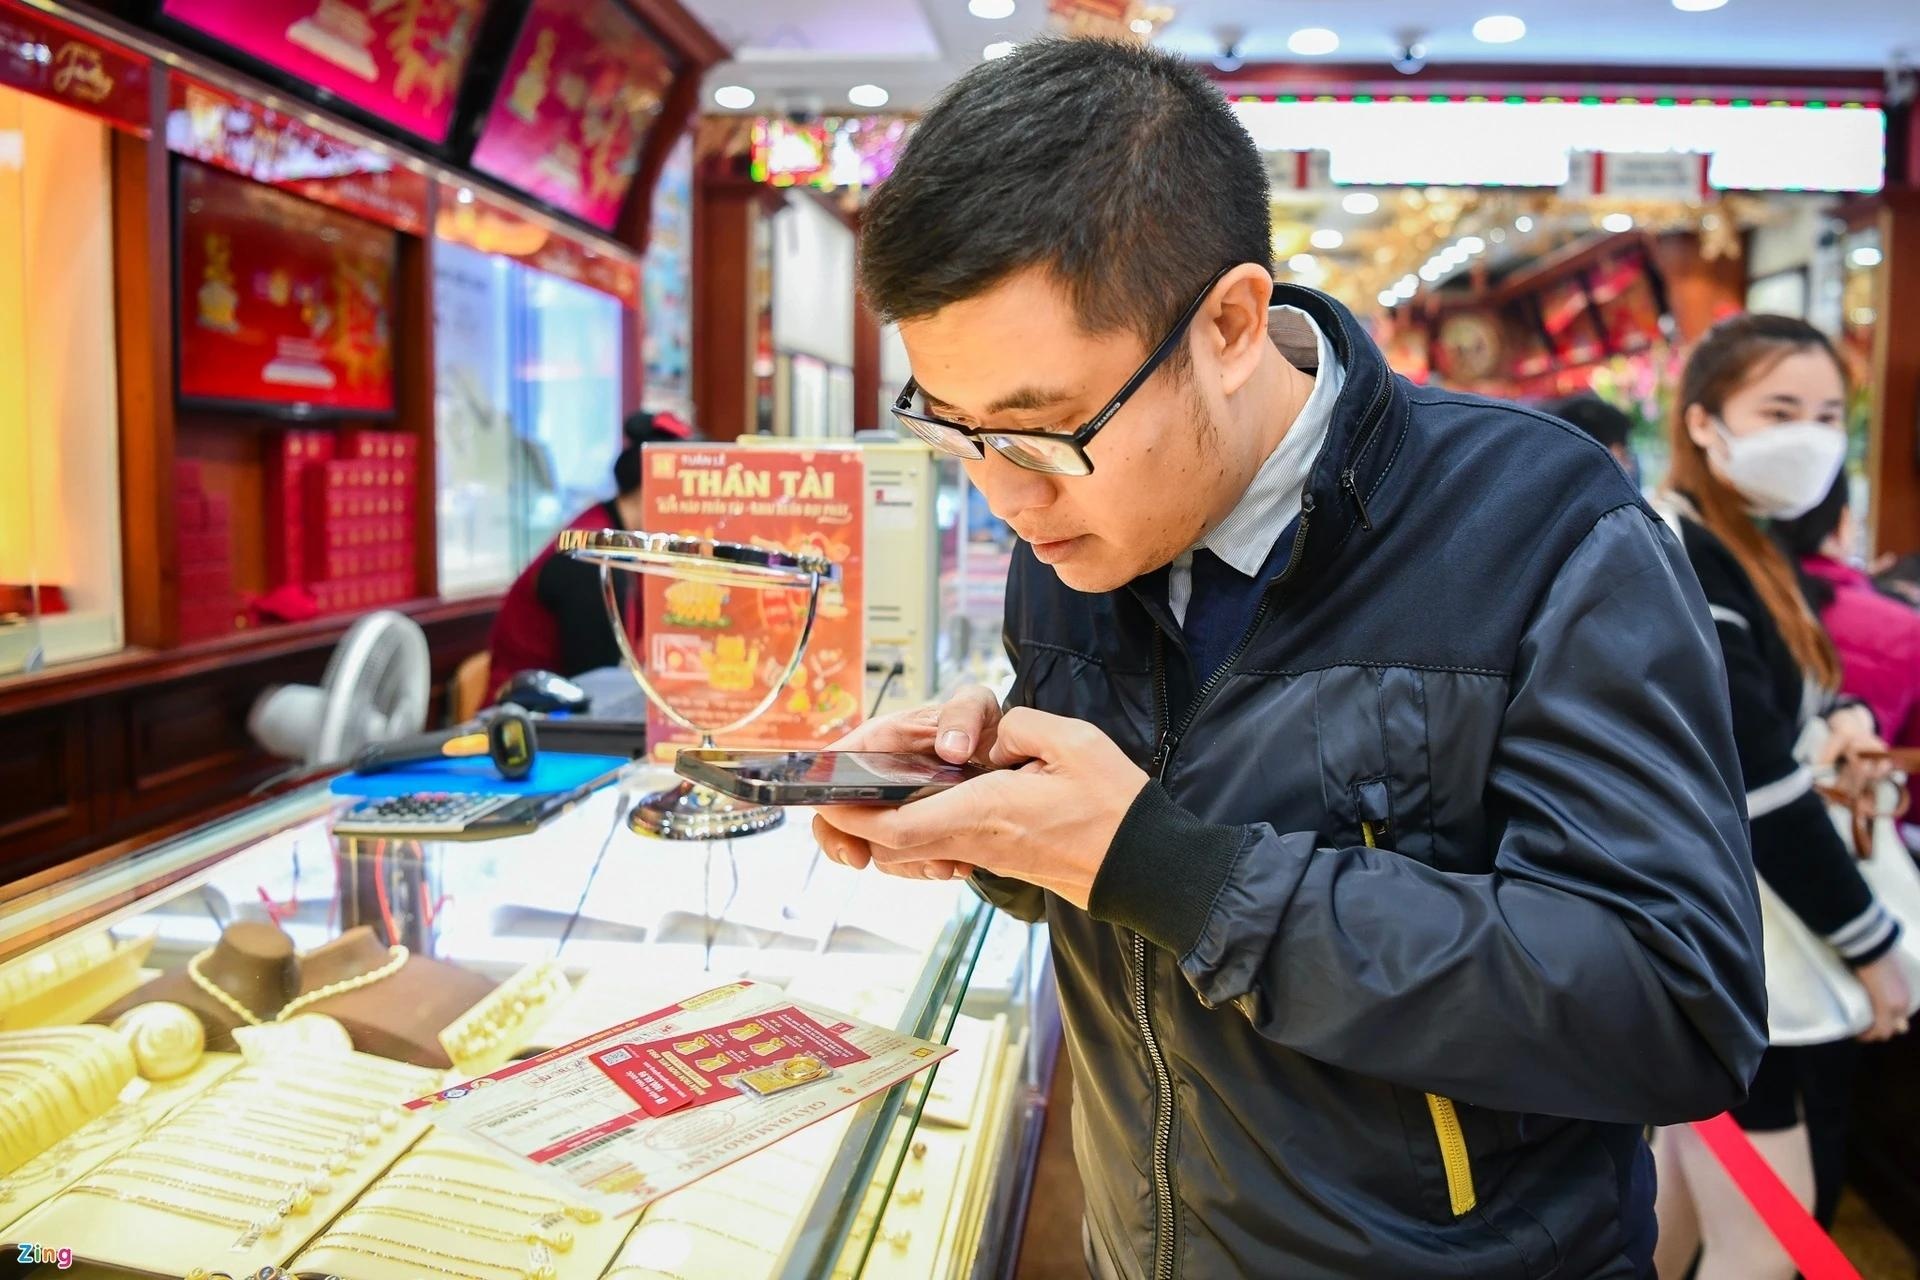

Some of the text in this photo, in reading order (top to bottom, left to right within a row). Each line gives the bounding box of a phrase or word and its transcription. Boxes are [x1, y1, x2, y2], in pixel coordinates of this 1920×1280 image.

[677, 463, 770, 498] THẦN
[779, 466, 835, 499] TÀI
[673, 1099, 832, 1174] GIẤY ĐẢM BẢO VÀNG
